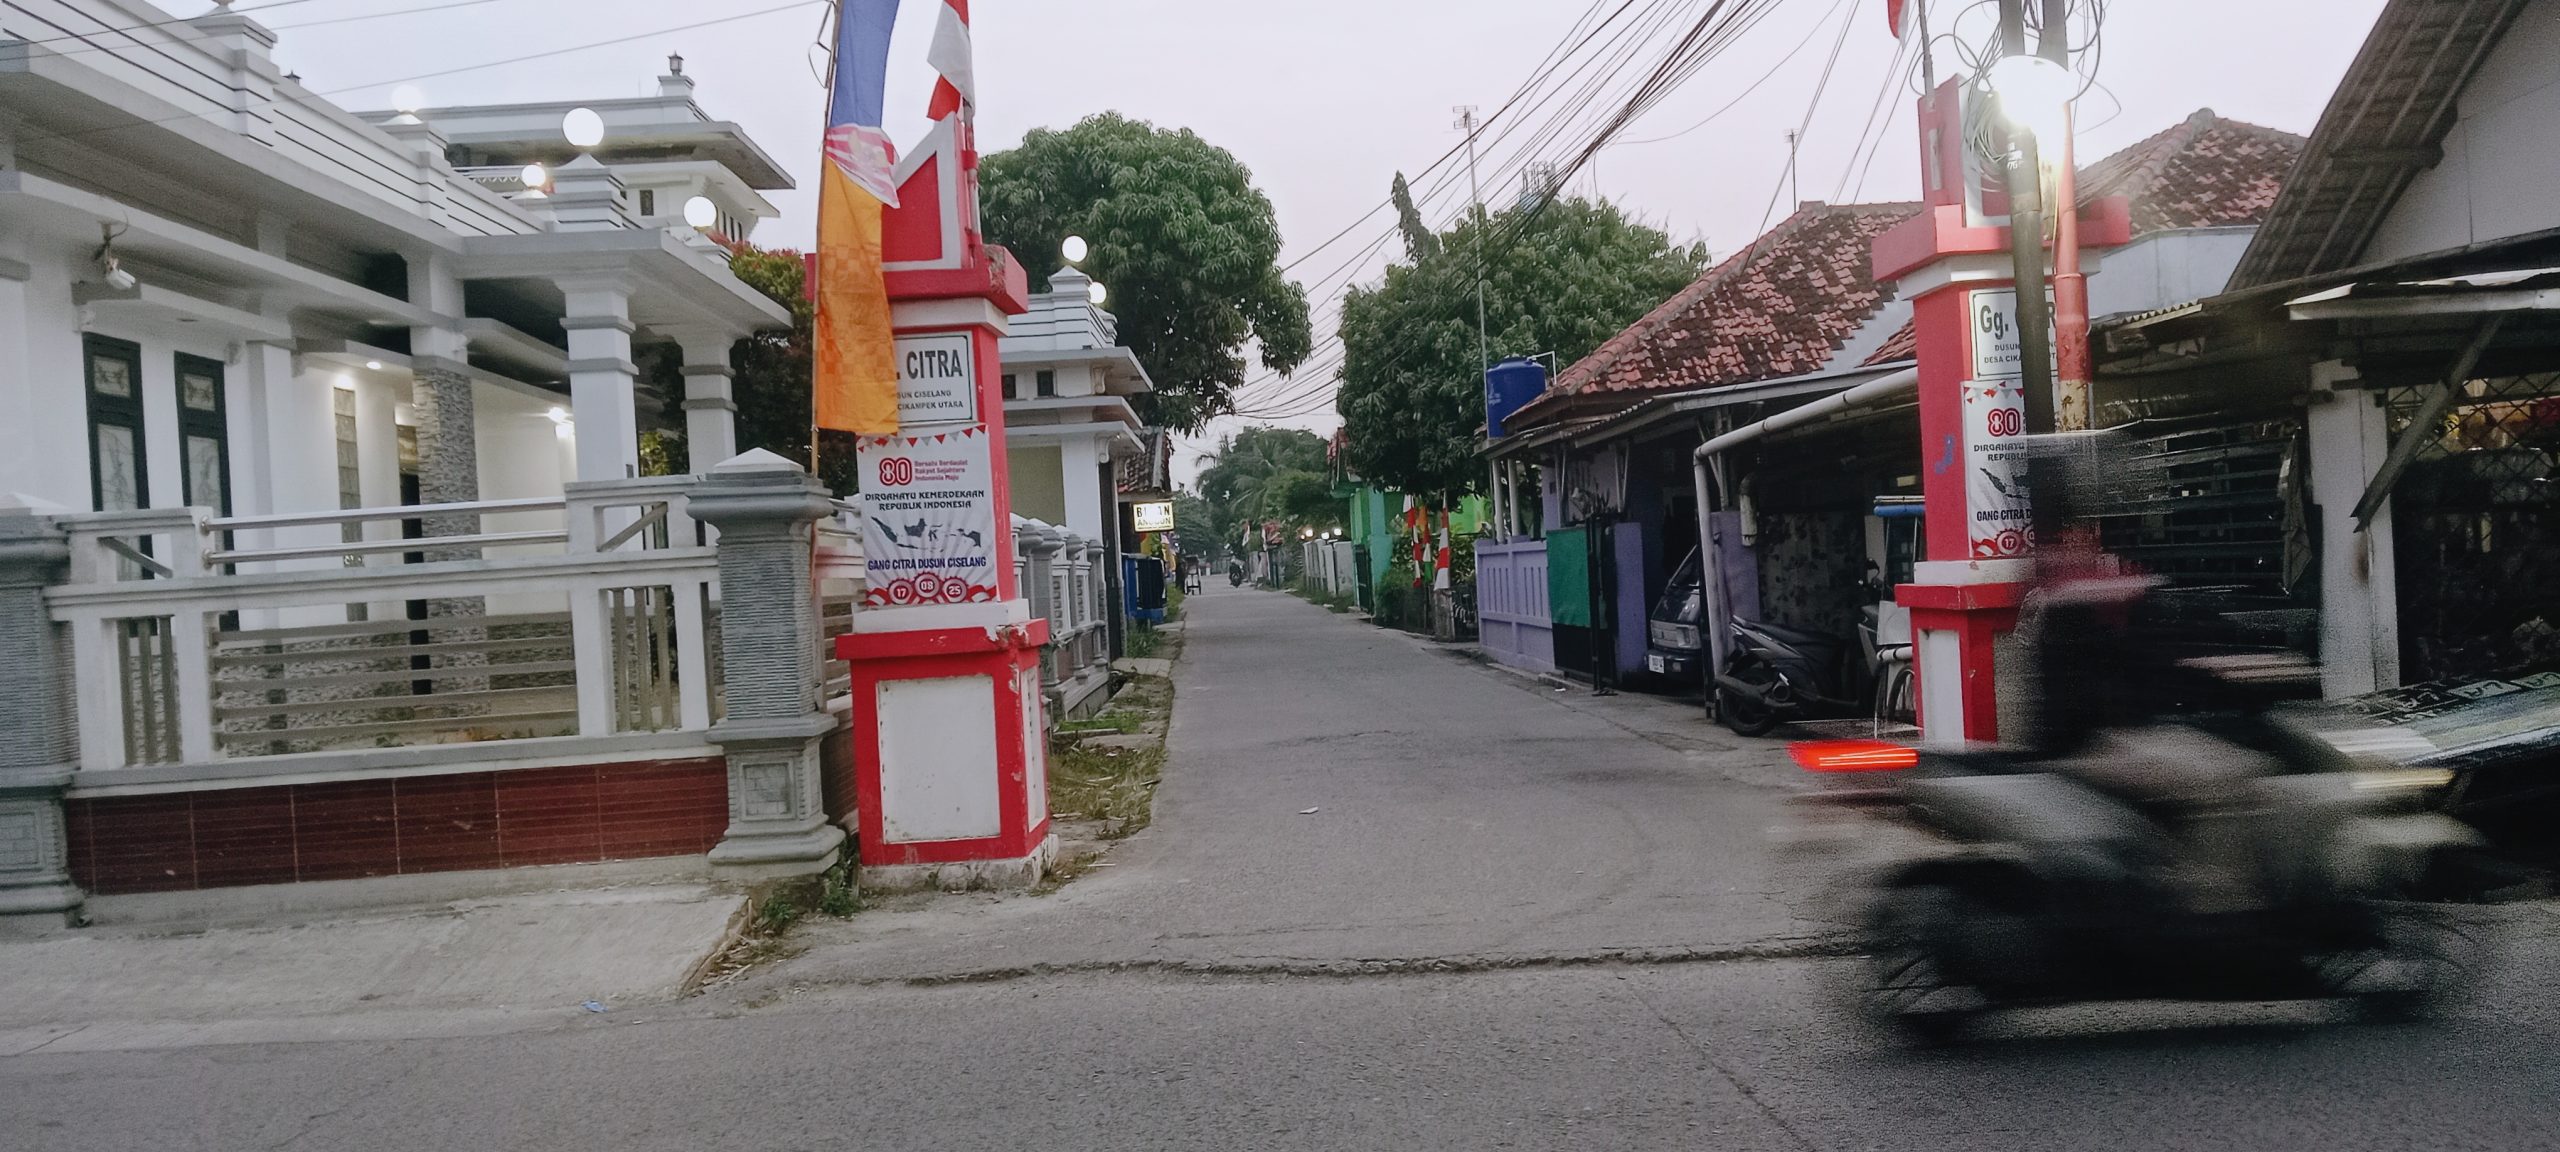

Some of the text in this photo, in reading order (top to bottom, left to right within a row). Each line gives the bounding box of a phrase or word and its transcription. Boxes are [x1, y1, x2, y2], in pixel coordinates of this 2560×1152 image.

[1980, 305, 2009, 340] Gg.
[906, 349, 963, 379] CITRA
[1984, 356, 2004, 364] DESA
[938, 400, 964, 409] UTARA
[1988, 408, 2021, 437] 80
[879, 457, 912, 486] 80
[865, 490, 985, 501] DIRGAHAYU KEMERDEKAAN
[879, 500, 972, 511] REPUBLIK INDONESIA
[1976, 510, 1998, 521] GANG
[2000, 509, 2024, 520] CITRA
[2004, 538, 2014, 548] 17
[868, 556, 987, 570] GANG CITRA DUSUN CISELANG
[896, 588, 907, 598] 17
[948, 585, 960, 595] 25
